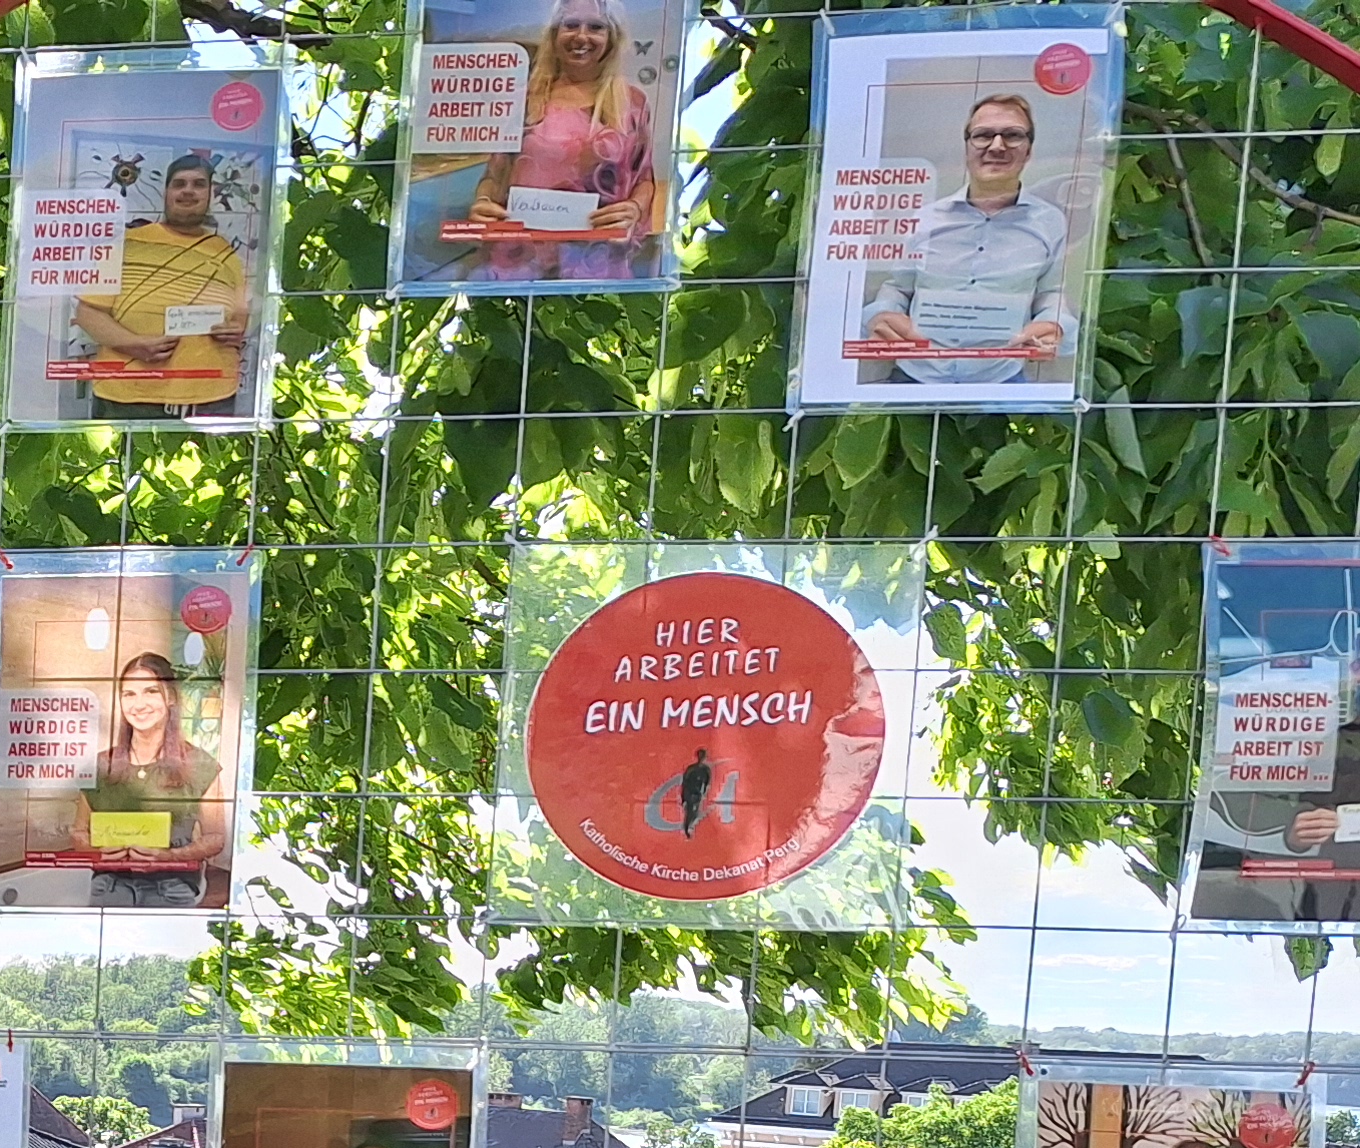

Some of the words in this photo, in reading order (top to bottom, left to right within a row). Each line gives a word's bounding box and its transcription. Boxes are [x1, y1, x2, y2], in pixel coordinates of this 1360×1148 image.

[432, 53, 522, 69] MENSCHEN-
[431, 76, 515, 93] WÜRDIGE
[428, 102, 484, 118] ARBEIT
[489, 102, 513, 117] IST
[427, 124, 455, 142] FÜR
[460, 126, 498, 141] MICH
[836, 168, 930, 186] MENSCHEN-
[35, 199, 120, 214] MENSCHEN-
[833, 192, 923, 210] WÜRDIGE
[34, 221, 114, 238] WÜRDIGE
[829, 219, 888, 235] ARBEIT
[894, 219, 920, 234] IST
[32, 247, 85, 261] ARBEIT
[90, 246, 112, 260] IST
[827, 242, 858, 260] FÜR
[862, 244, 903, 259] MICH
[31, 268, 59, 284] FÜR
[63, 269, 99, 284] MICH
[655, 617, 739, 646] HIER
[614, 648, 780, 683] ARBEITET
[10, 697, 94, 712] MENSCHEN-
[1235, 693, 1332, 708] MENSCHEN-
[585, 699, 646, 734] EIN
[660, 690, 812, 728] MENSCH
[9, 718, 88, 734] WÜRDIGE
[1234, 714, 1326, 731] WÜRDIGE
[8, 742, 59, 756] ARBEIT
[64, 742, 86, 756] IST
[1231, 741, 1292, 756] ARBEIT
[1298, 741, 1324, 756] IST
[7, 762, 34, 778] FÜR
[39, 765, 75, 778] MICH
[1230, 763, 1262, 780] FÜR
[1267, 765, 1308, 780] MICH
[579, 817, 649, 875] Katholische
[650, 861, 699, 882] Kirche
[703, 857, 766, 882] Dekanat
[764, 836, 800, 864] Perg
